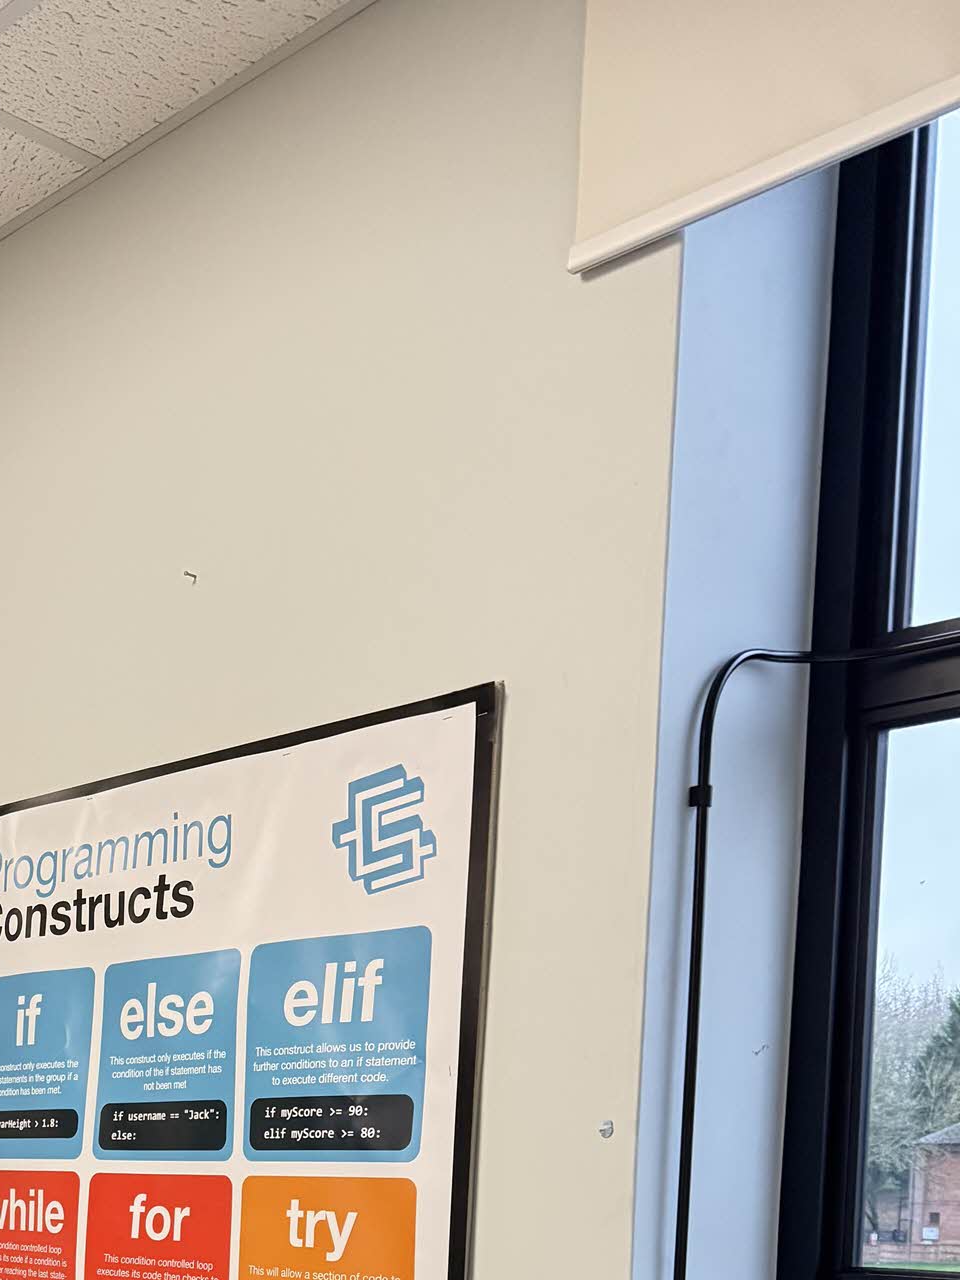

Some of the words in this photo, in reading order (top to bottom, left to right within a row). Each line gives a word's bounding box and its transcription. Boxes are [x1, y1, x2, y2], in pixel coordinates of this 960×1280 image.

[283, 958, 385, 1026] elif
[120, 982, 215, 1040] else
[15, 994, 42, 1047] if
[255, 1046, 271, 1056] This
[273, 1043, 313, 1055] construct
[315, 1043, 346, 1053] allows
[349, 1043, 361, 1051] us
[364, 1041, 375, 1051] to
[377, 1039, 415, 1052] provide
[253, 1061, 279, 1071] further
[280, 1059, 326, 1070] conditions
[328, 1058, 338, 1067] to
[356, 1057, 362, 1066] if
[365, 1055, 416, 1066] statement
[271, 1076, 280, 1085] to
[281, 1074, 316, 1085] execute
[318, 1072, 357, 1083] different
[360, 1071, 388, 1082] code.
[113, 1110, 123, 1121] if
[127, 1112, 166, 1121] username
[184, 1109, 219, 1119] "Jack":
[264, 1106, 275, 1117] if
[280, 1106, 322, 1120] myScore
[348, 1105, 367, 1116] 90:
[42, 1118, 58, 1127] 1.8:
[111, 1129, 135, 1140] else:
[263, 1128, 285, 1139] elif
[290, 1127, 334, 1141] myScore
[360, 1127, 380, 1138] 80:
[129, 1193, 191, 1241] for
[286, 1199, 358, 1262] try
[249, 1264, 264, 1275] This
[265, 1266, 278, 1276] will
[280, 1267, 302, 1278] allow
[305, 1271, 310, 1279] a
[314, 1271, 346, 1280] section
